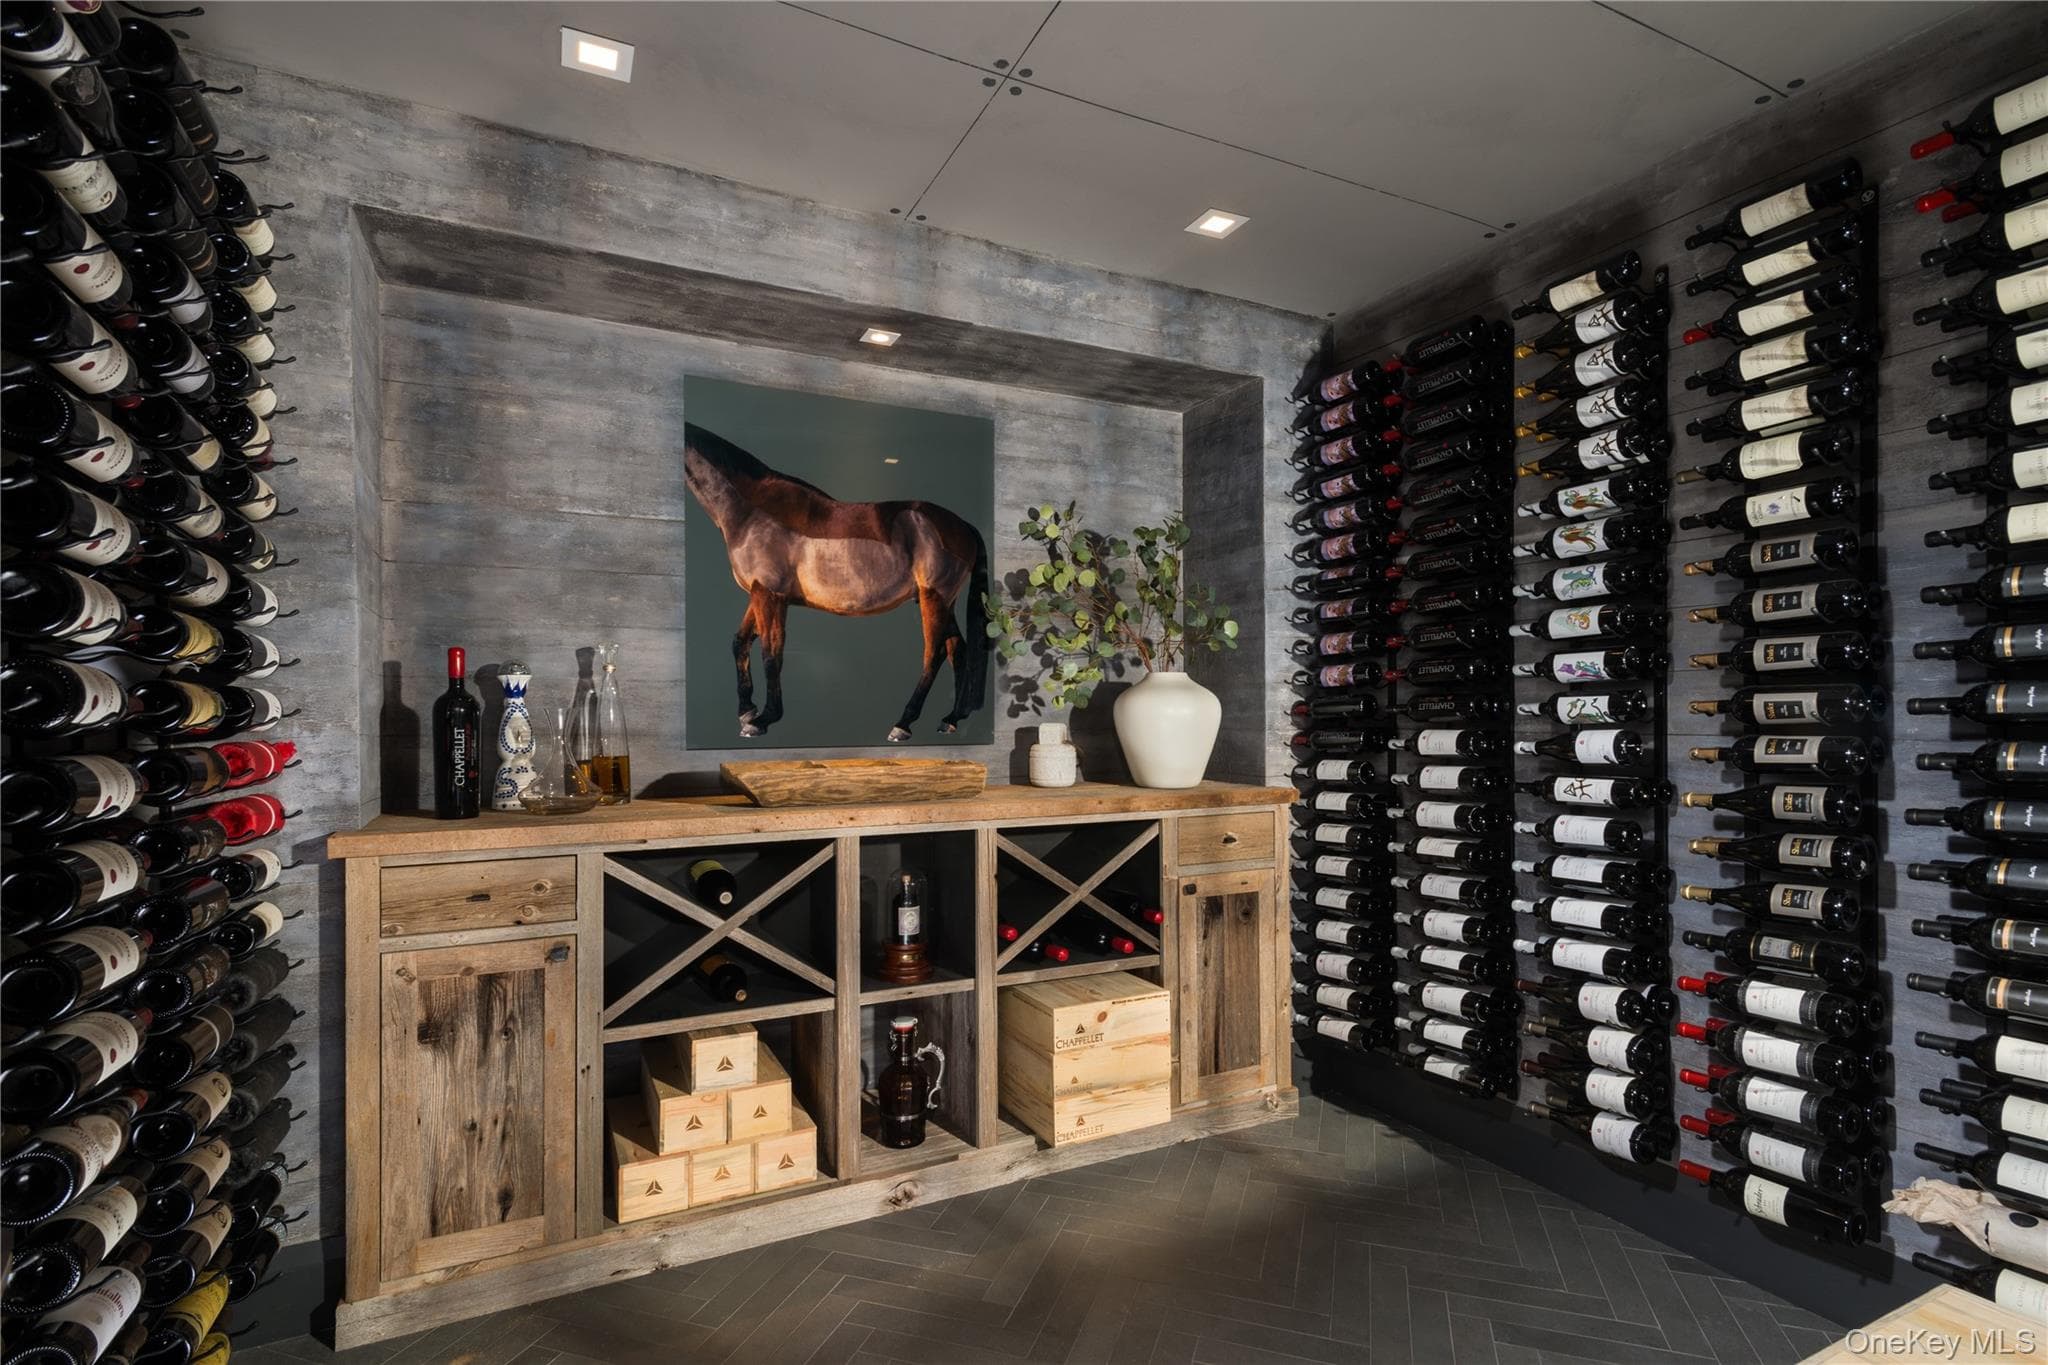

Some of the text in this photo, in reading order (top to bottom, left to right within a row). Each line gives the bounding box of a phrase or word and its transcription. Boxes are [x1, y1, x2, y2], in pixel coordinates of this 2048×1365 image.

[454, 727, 465, 786] CHAPPELLET
[1056, 1033, 1104, 1049] CHAPPELLET
[1056, 1124, 1104, 1143] CHAPPELLET
